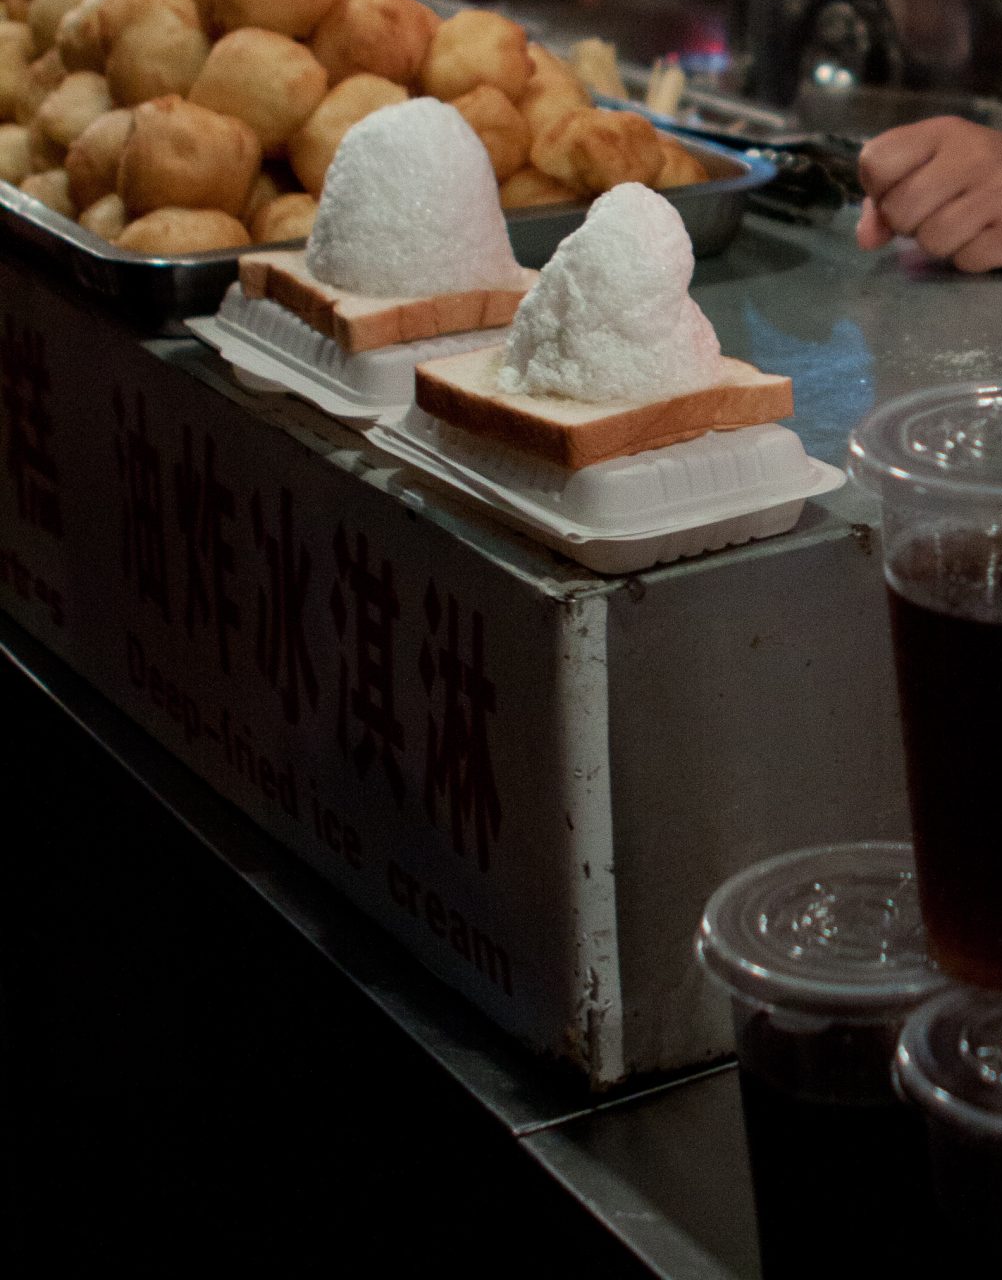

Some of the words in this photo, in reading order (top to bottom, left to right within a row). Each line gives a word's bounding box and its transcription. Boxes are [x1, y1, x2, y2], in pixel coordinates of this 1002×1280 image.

[111, 383, 503, 871] 油炸冰淇淋
[125, 629, 300, 819] Deep-fried
[310, 779, 363, 871] ice
[387, 858, 514, 997] cream
